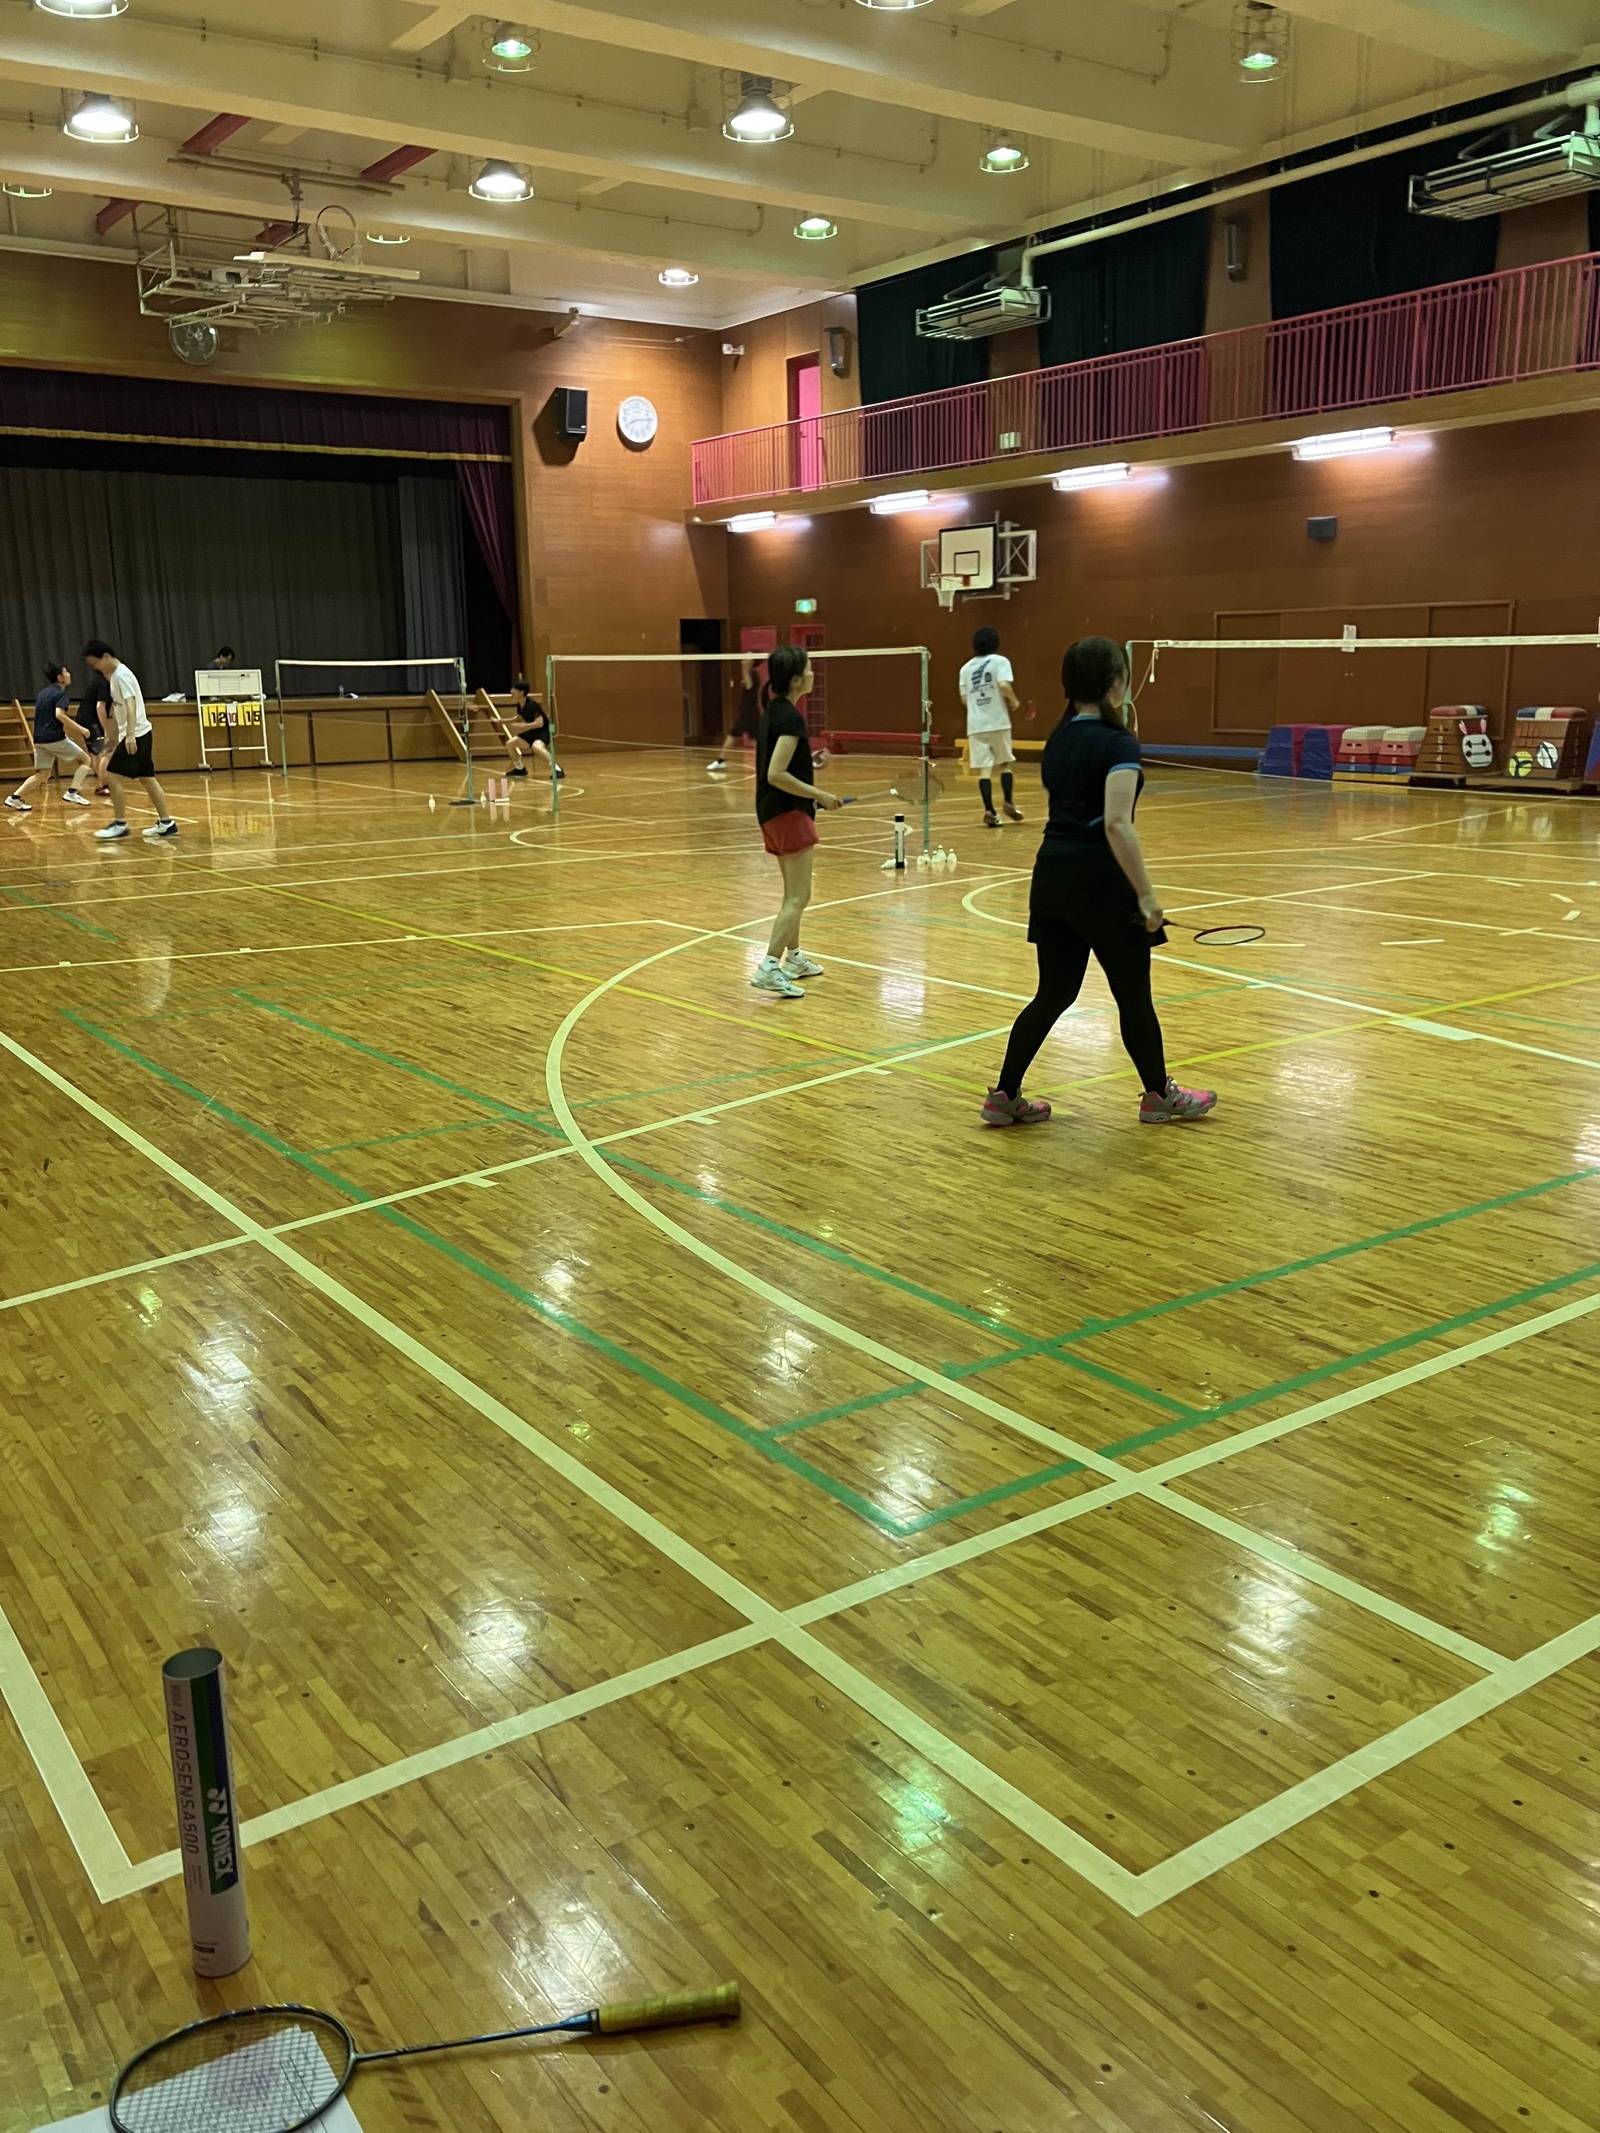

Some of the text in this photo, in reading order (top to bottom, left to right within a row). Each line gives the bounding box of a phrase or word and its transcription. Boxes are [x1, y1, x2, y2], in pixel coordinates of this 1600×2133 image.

[211, 711, 227, 724] 12
[246, 710, 262, 723] 15
[210, 1816, 234, 1881] YONEX
